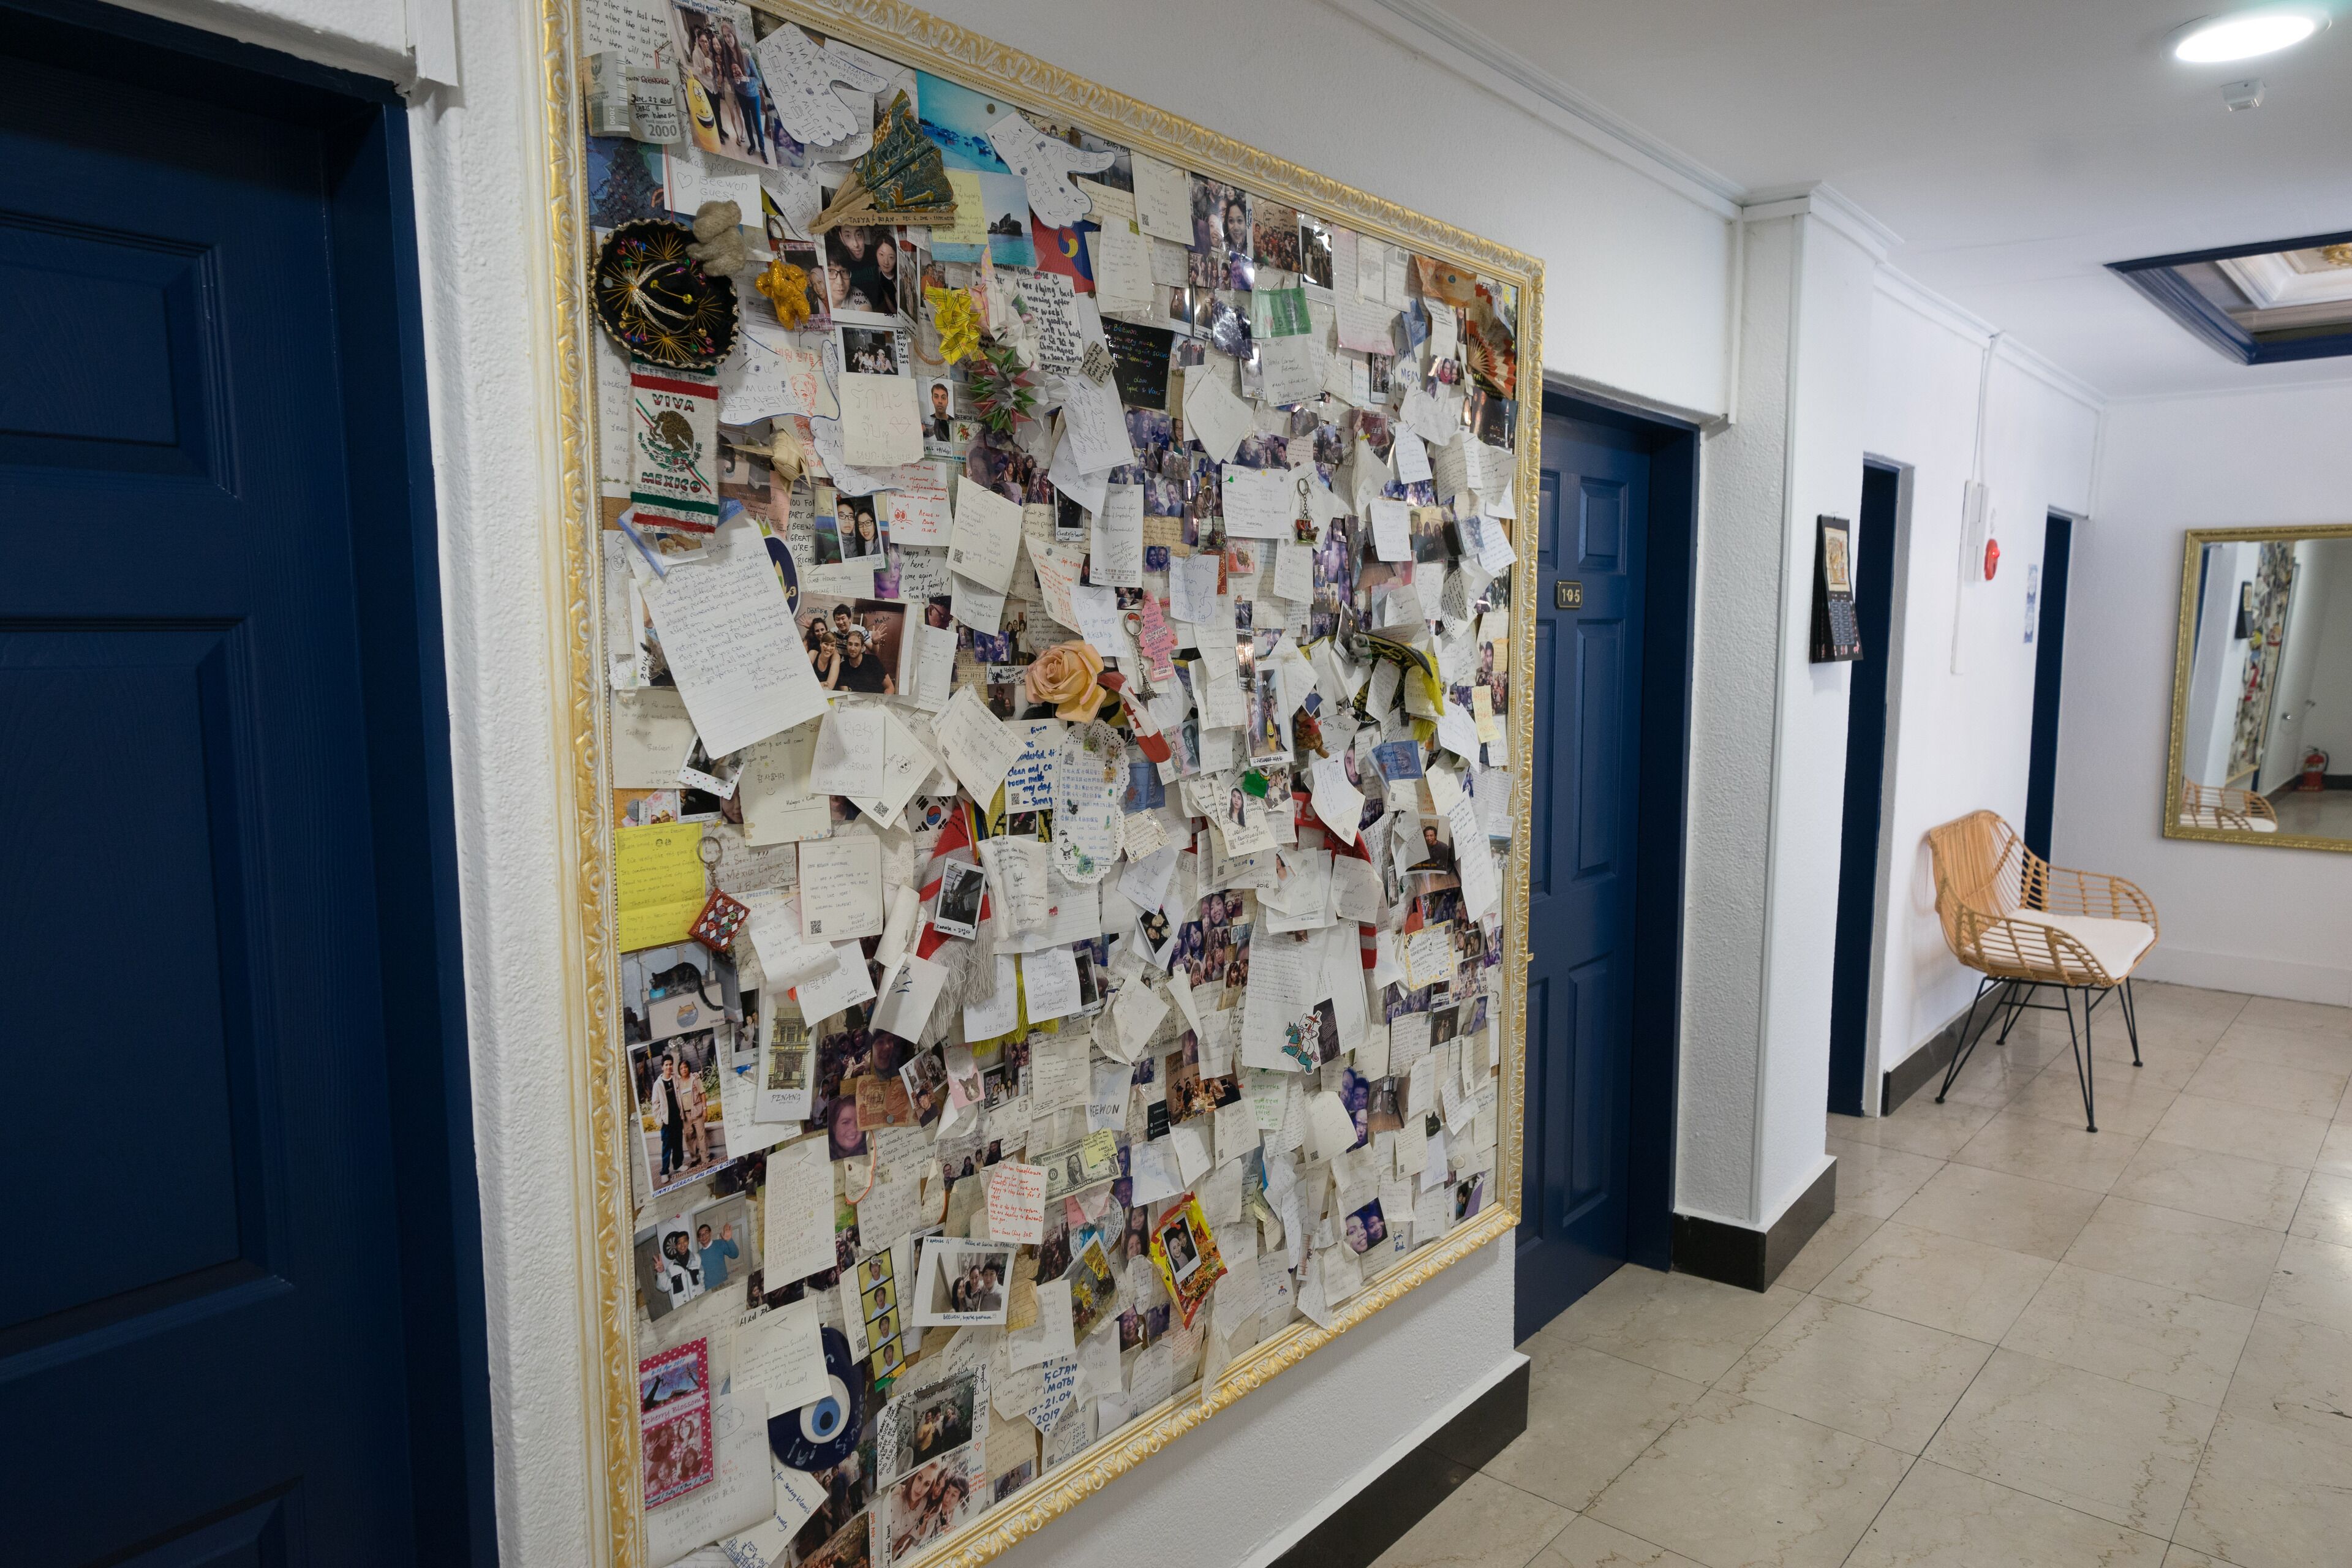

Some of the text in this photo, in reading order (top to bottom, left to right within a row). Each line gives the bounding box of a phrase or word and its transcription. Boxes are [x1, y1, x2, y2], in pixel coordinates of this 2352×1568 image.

[587, 7, 650, 32] Only the last
[624, 7, 647, 20] the last
[588, 20, 650, 45] Only the last
[589, 33, 653, 62] Only will you
[649, 124, 677, 137] 2000
[1027, 295, 1070, 308] morning after
[1060, 290, 1074, 298] back
[652, 393, 695, 412] VIVA
[641, 472, 702, 493] MEXICO
[1562, 589, 1580, 603] 105
[771, 1093, 801, 1103] PENANG
[1036, 1408, 1060, 1425] 2019
